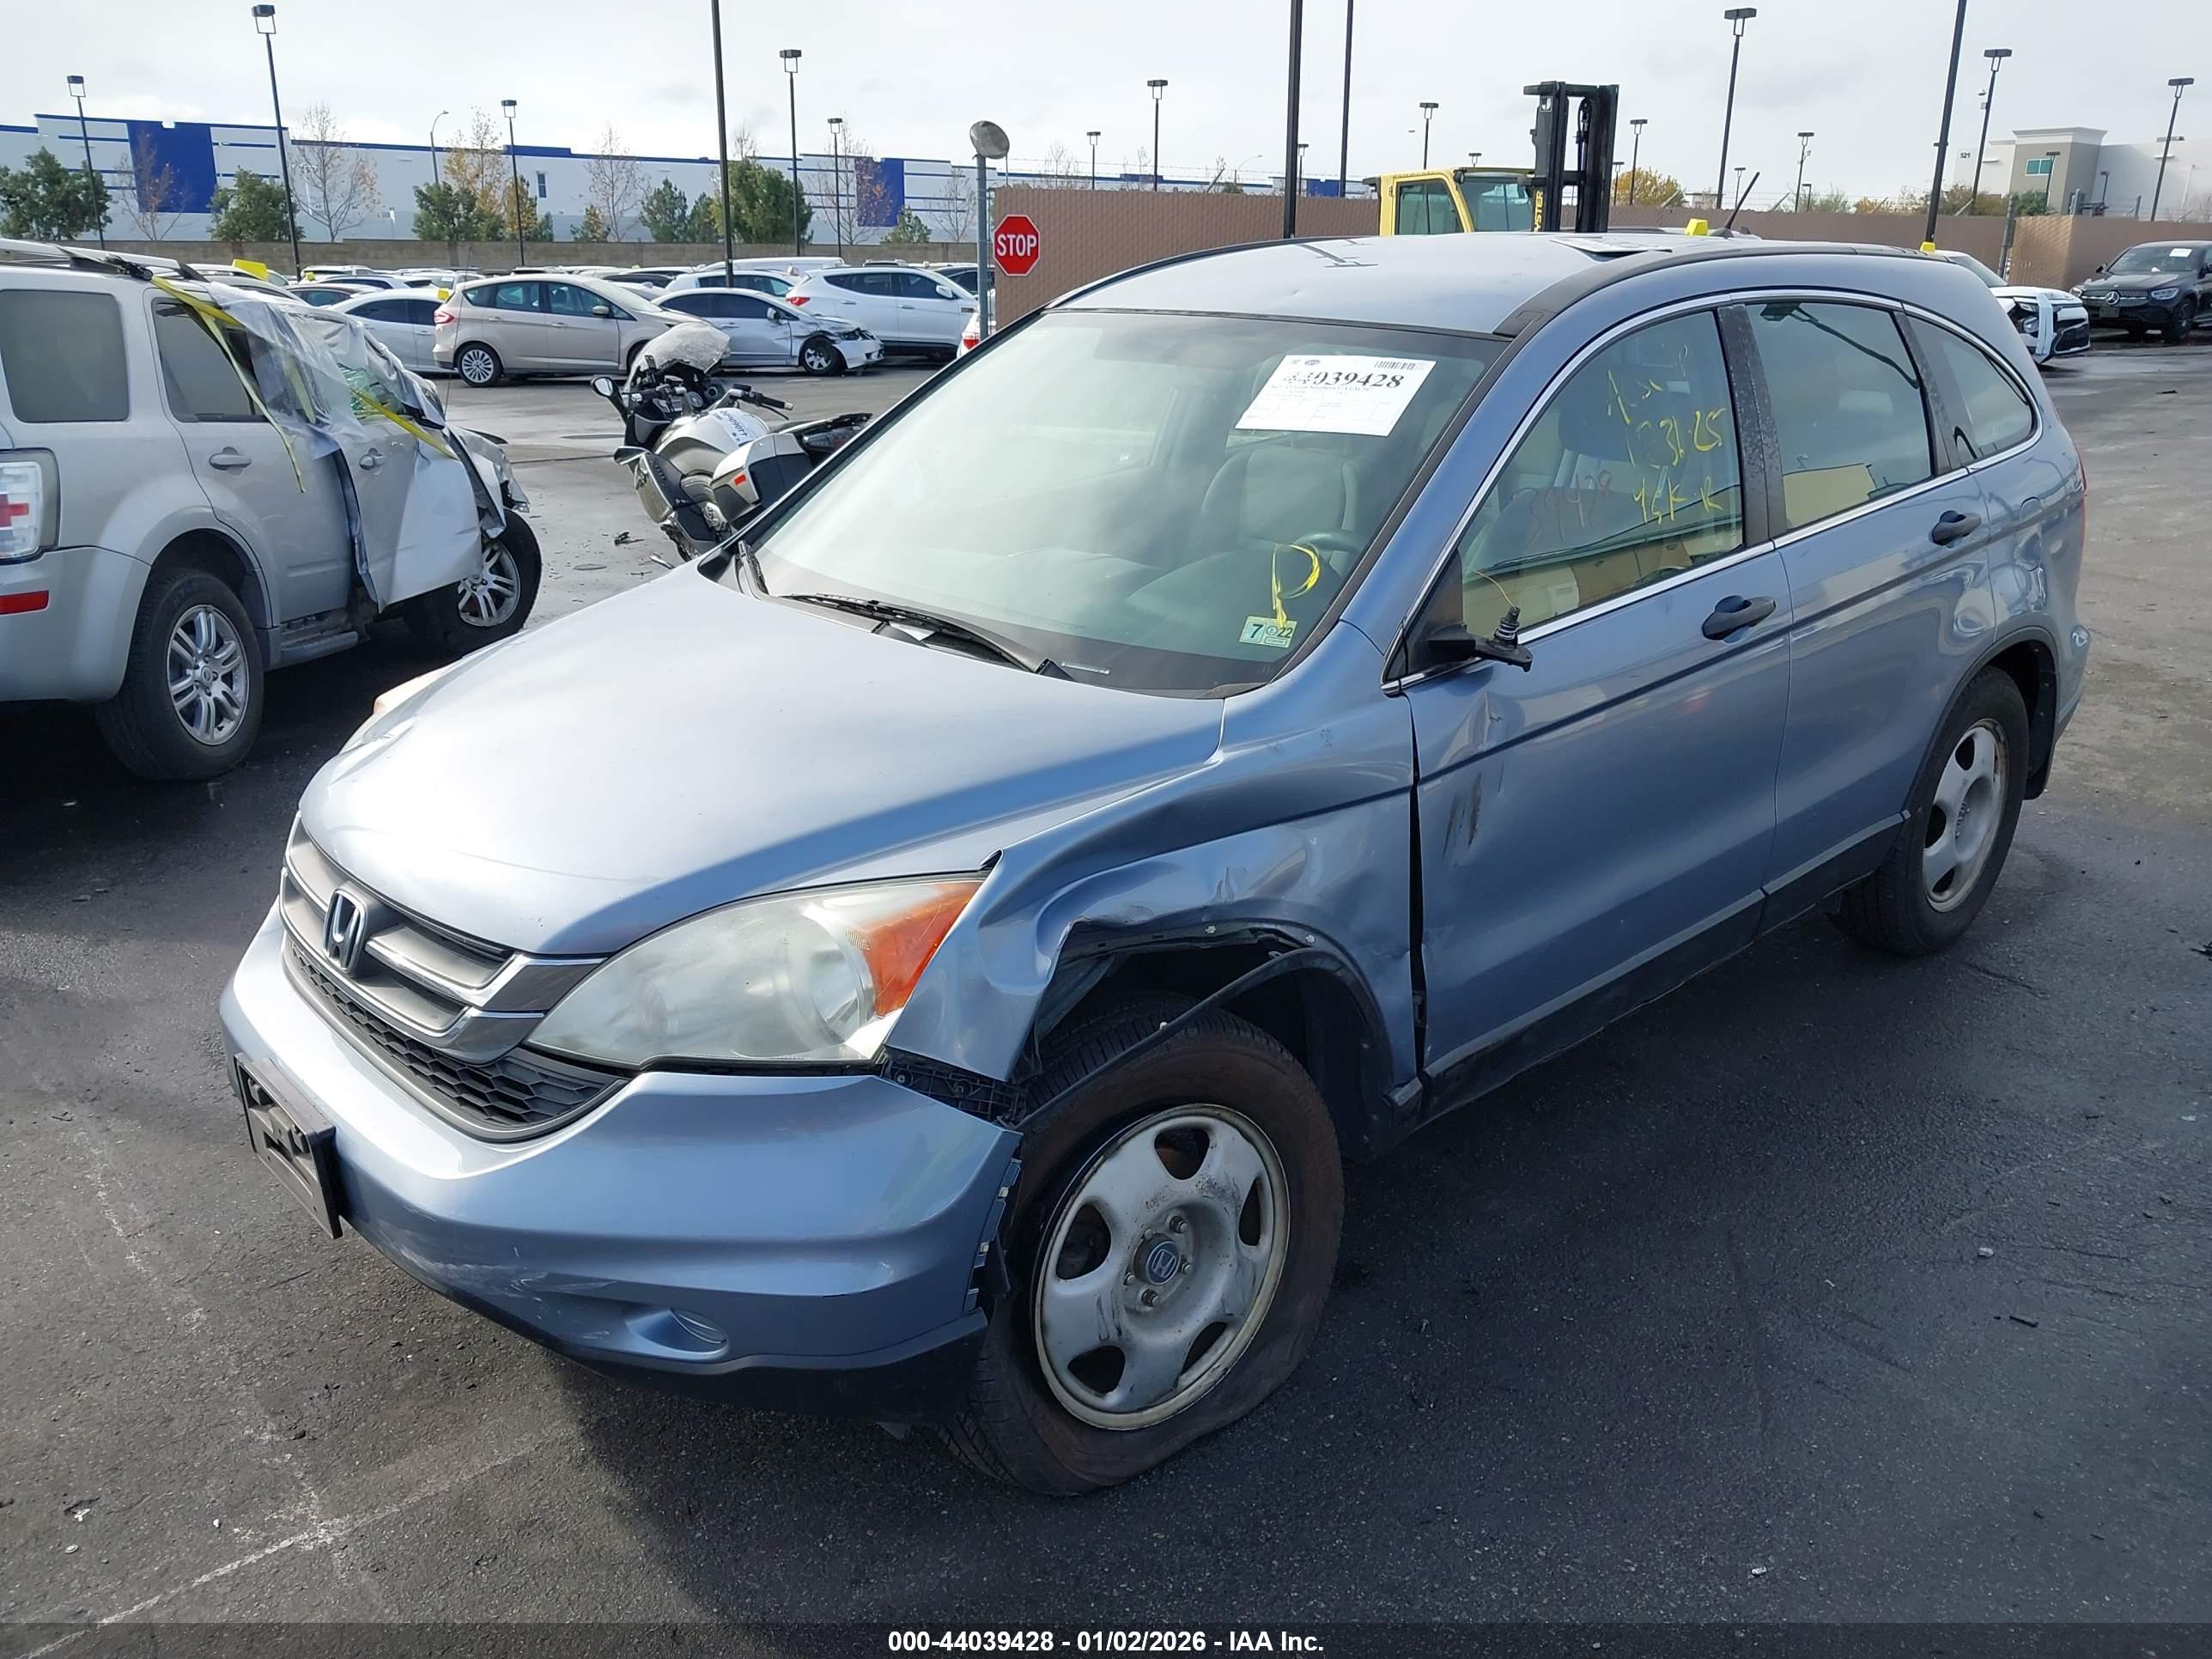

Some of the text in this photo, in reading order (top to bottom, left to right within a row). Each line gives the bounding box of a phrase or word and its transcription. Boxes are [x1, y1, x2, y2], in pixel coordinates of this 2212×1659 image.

[1534, 191, 1544, 233] YSTER
[996, 234, 1037, 257] STOP
[1250, 623, 1263, 638] 7
